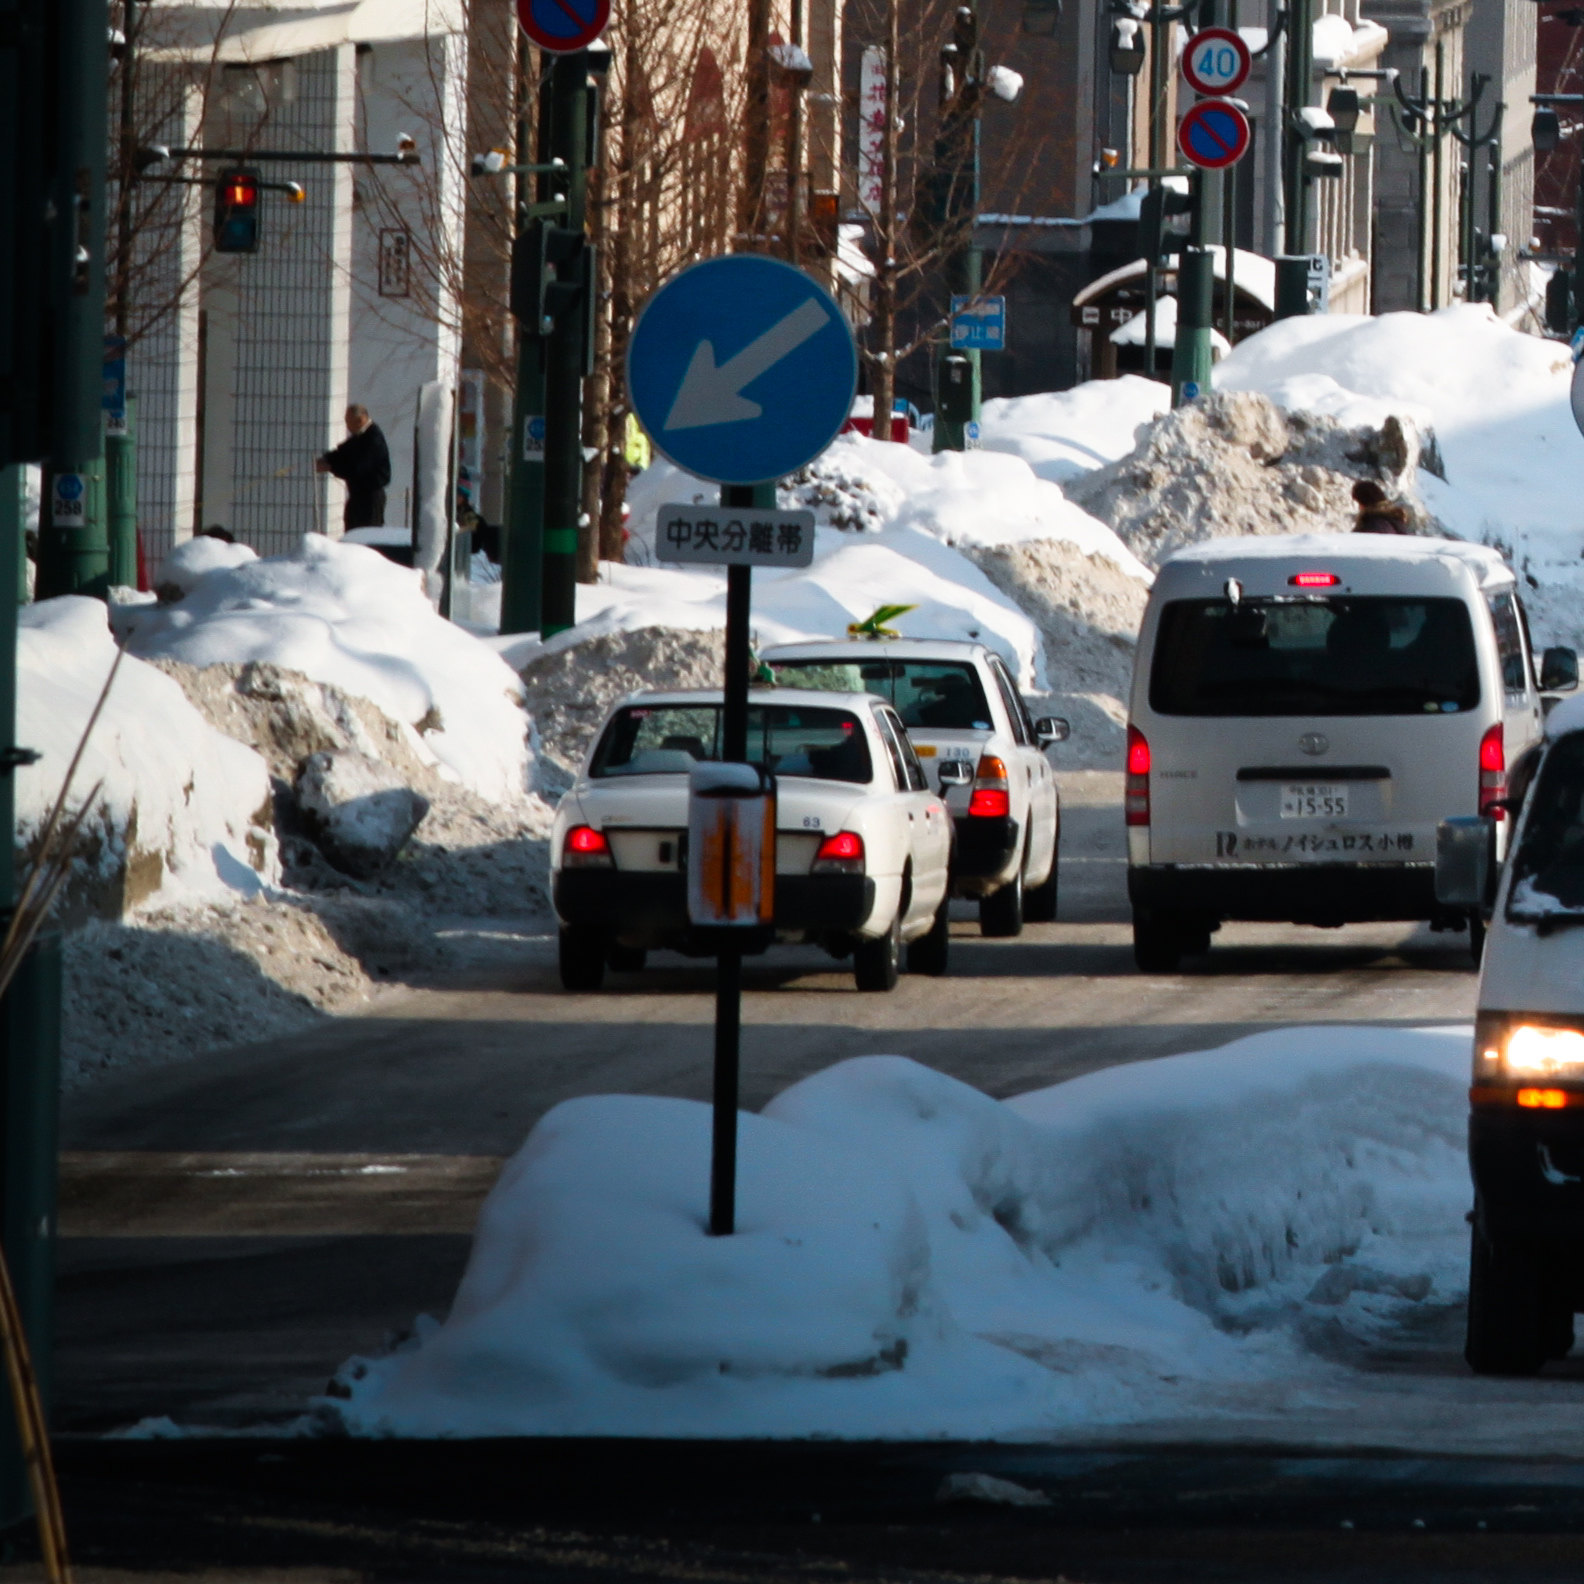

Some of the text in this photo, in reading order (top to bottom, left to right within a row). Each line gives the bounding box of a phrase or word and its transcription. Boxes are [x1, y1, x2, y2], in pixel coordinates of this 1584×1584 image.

[1198, 48, 1235, 78] 40
[667, 518, 802, 554] 中央分離帯
[1297, 797, 1345, 815] 15-55
